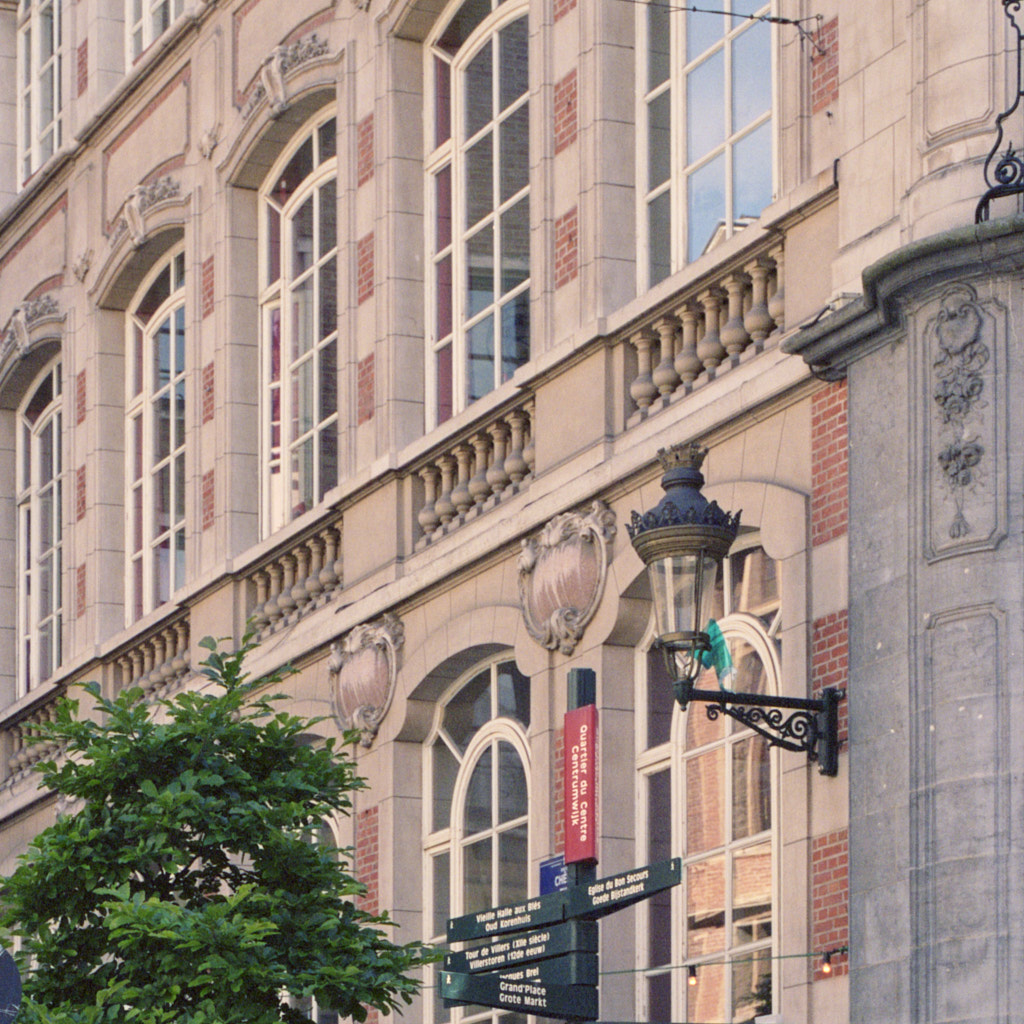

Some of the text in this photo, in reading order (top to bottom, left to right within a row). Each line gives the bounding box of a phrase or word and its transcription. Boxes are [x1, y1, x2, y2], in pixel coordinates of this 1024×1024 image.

[571, 745, 580, 826] Centrumwijk
[579, 724, 588, 842] Quartier du Centre
[605, 880, 614, 891] du
[626, 870, 649, 884] Secours
[476, 911, 496, 924] Vieille
[496, 907, 513, 919] Halle
[514, 904, 526, 915] aux
[485, 914, 532, 932] Oud Korenhuis
[465, 949, 479, 961] Tour
[480, 946, 489, 957] de
[491, 942, 511, 954] Villers
[525, 966, 540, 978] Brel
[499, 993, 547, 1007] Grote Markt
